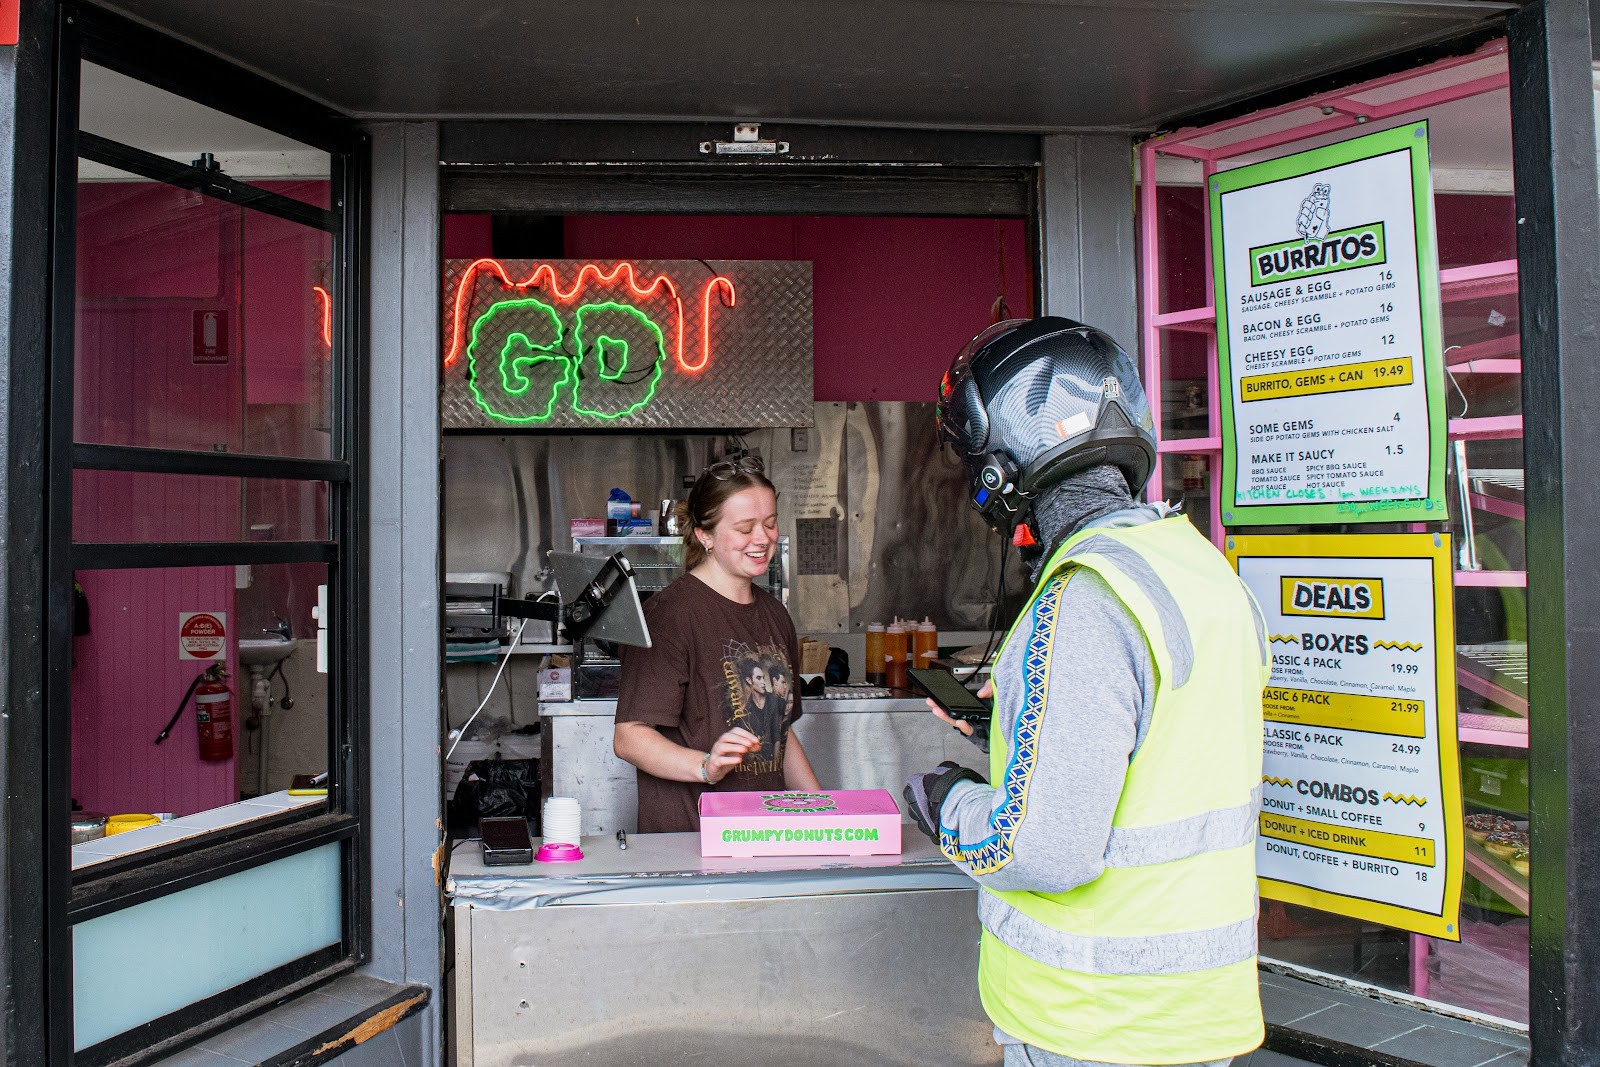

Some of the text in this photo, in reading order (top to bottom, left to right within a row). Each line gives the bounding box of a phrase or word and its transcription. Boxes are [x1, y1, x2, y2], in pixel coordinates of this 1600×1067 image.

[1258, 233, 1376, 276] BURRITOS
[1379, 270, 1393, 280] 16
[1241, 280, 1332, 304] SAUSAGE & EGG
[1274, 298, 1300, 308] CHEESY
[1301, 292, 1337, 303] SCRAMBLE
[1346, 286, 1374, 296] POTATO
[1376, 282, 1396, 290] GEMS
[1380, 302, 1394, 312] 16
[1243, 314, 1321, 334] BACON & EGG
[1270, 330, 1294, 338] CHEESY
[1296, 324, 1332, 334] SCRAMBLE
[1340, 318, 1368, 328] POTATO
[1370, 315, 1390, 324] GEMS
[1381, 334, 1395, 345] 12
[467, 298, 666, 421] GD
[1244, 346, 1314, 363] CHEESY EGG
[1245, 362, 1270, 370] CHEESY
[1271, 358, 1306, 368] SCRAMBLE
[1313, 353, 1340, 362] POTATO
[1342, 350, 1362, 358] GEMS
[1246, 379, 1292, 392] BURRITO,
[1296, 375, 1326, 387] GEMS
[1338, 370, 1364, 382] CAN
[1374, 365, 1404, 378] 19.49
[1394, 412, 1400, 422] 4
[1250, 420, 1314, 434] SOME GEMS
[1250, 434, 1264, 442] SIDE
[1341, 426, 1374, 436] CHICKEN
[1252, 449, 1335, 464] MAKE IT SAUCY
[1385, 444, 1404, 455] 1.5
[1342, 462, 1367, 470] SAUCE
[1280, 474, 1301, 482] SAUCE
[1322, 480, 1346, 488] SAUCE
[1360, 484, 1422, 496] WEEKDAYS
[1294, 584, 1370, 610] DEALS
[1301, 632, 1369, 656] BOXES
[1272, 655, 1342, 669] ASSIC 4 PACK
[1391, 664, 1418, 674] 19.99
[1398, 685, 1416, 693] Maple
[1292, 692, 1298, 702] 6
[1302, 693, 1330, 706] PACK
[1391, 702, 1419, 713] 21.99
[1263, 728, 1344, 746] LASSIC 6 PACK
[1263, 740, 1284, 748] HOOSE
[1392, 743, 1420, 755] 24.99
[1400, 765, 1420, 774] Maple
[1296, 779, 1380, 806] COMBOS
[1263, 798, 1296, 812] DONUT
[1306, 804, 1338, 819] SMALL
[1341, 811, 1382, 826] COFFEE
[1265, 820, 1367, 847] DONUT + ICED DRINK
[1418, 822, 1425, 832] 9
[721, 827, 879, 842] GRUMPYDONUTS.COM
[1414, 846, 1427, 857] 11
[1266, 842, 1399, 876] DONUT, COFFEE + BURRITO
[1416, 872, 1428, 882] 18
